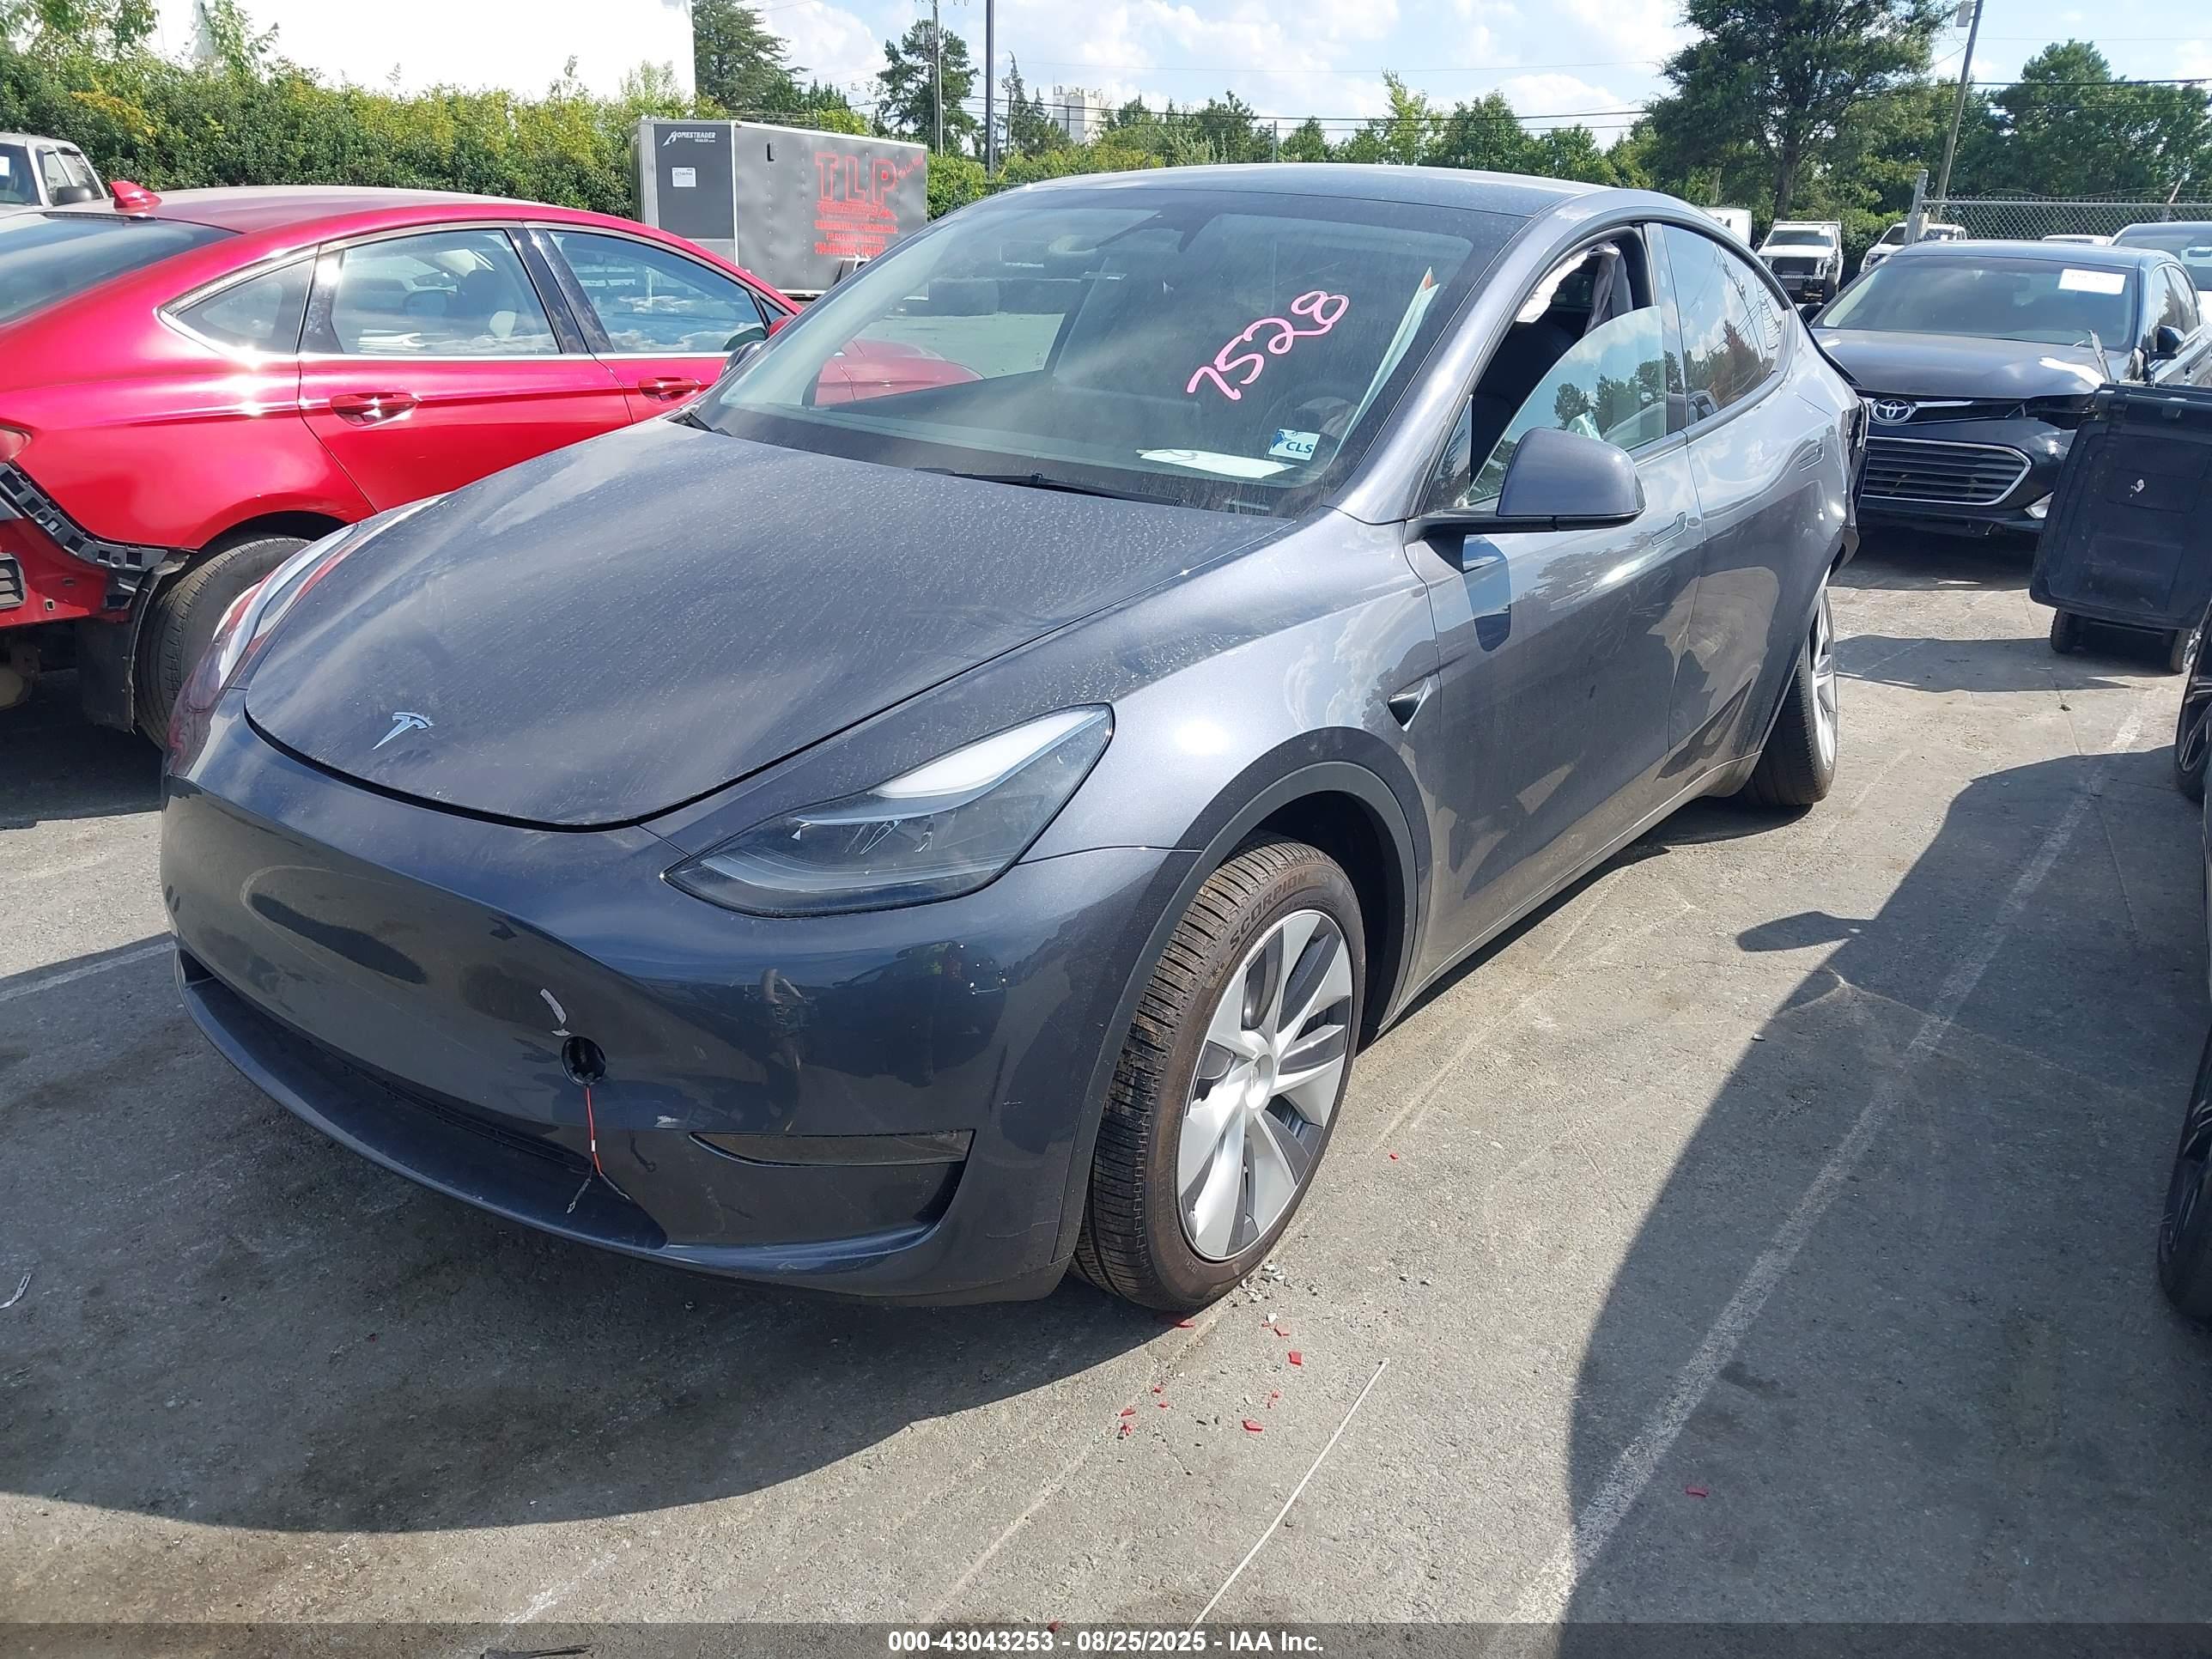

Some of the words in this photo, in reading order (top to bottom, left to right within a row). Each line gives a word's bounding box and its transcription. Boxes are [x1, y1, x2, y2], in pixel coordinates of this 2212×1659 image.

[815, 152, 896, 205] TLP
[1187, 290, 1349, 400] 7528
[1285, 441, 1314, 453] CLS
[1230, 871, 1308, 951] SCORPION
